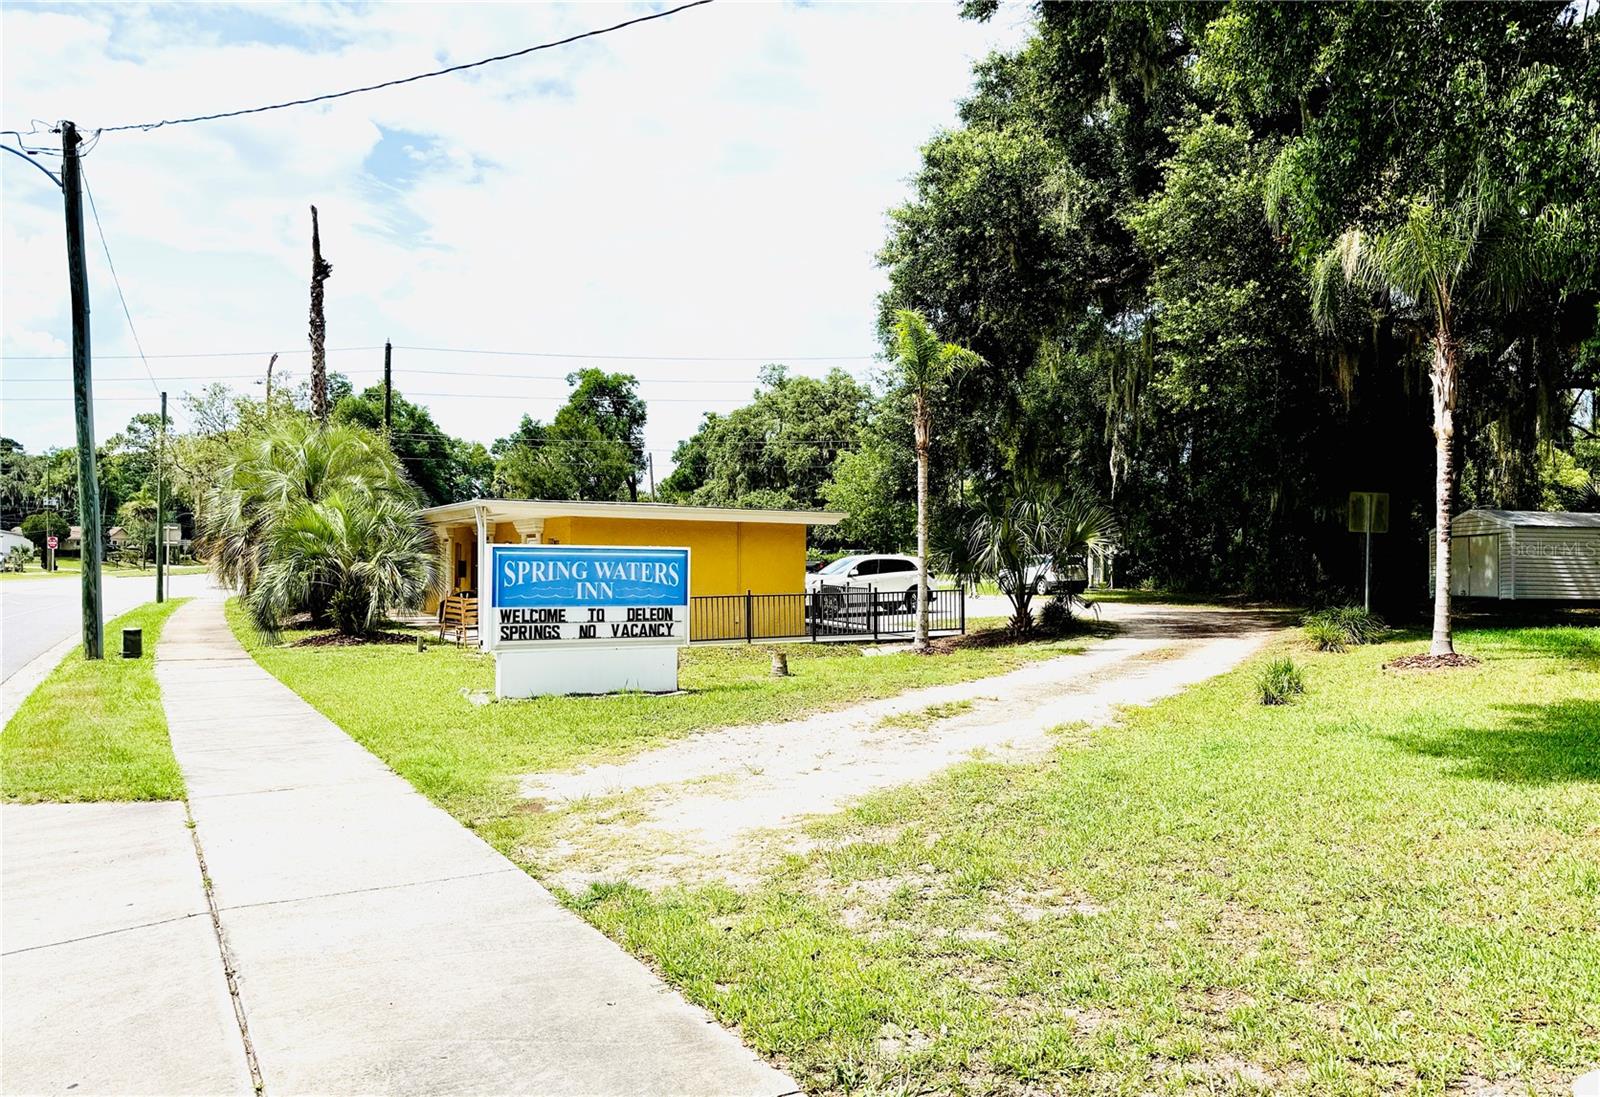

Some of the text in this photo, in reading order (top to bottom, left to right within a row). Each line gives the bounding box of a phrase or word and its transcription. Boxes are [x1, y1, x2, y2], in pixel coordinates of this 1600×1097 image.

[503, 560, 680, 587] SPRING WATERS
[576, 581, 614, 600] INN
[500, 607, 673, 624] WELCOME TO DELEON
[500, 623, 674, 640] SPRINGS NO VACANCY
